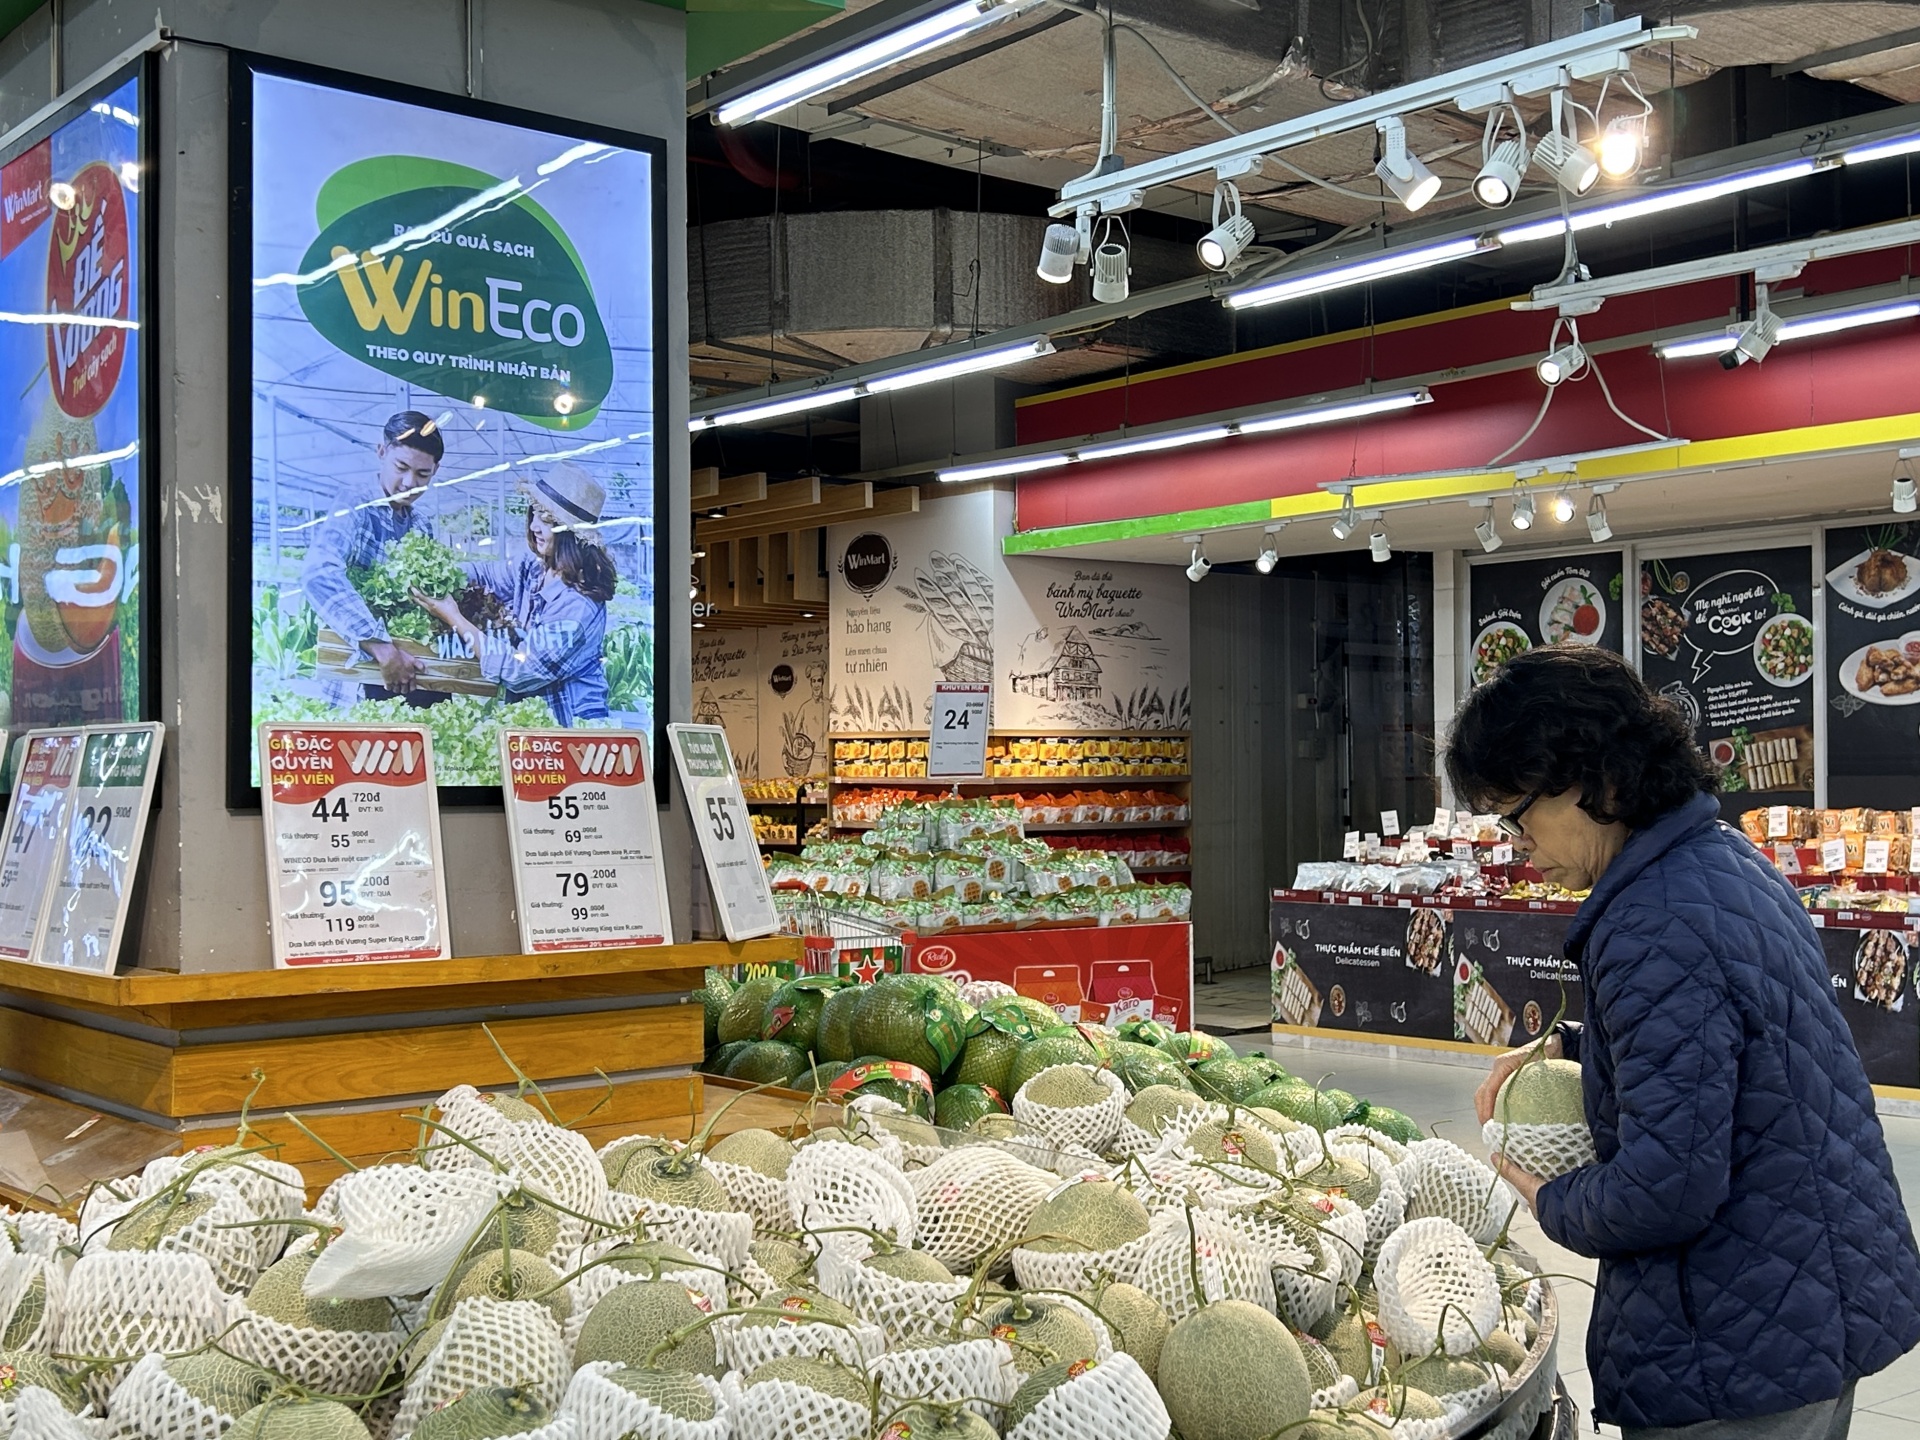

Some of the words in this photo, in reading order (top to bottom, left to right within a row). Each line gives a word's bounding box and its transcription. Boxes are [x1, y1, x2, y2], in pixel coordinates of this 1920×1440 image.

[456, 233, 490, 251] QUẢ
[493, 240, 535, 258] SẠCH
[330, 245, 586, 348] WinEco
[366, 345, 409, 361] THEO
[412, 350, 446, 366] QUY
[449, 354, 494, 373] TRÌNH
[497, 361, 537, 379] NHẬT
[540, 364, 571, 383] BẢN
[847, 553, 886, 570] WinMart
[1046, 582, 1076, 598] bánh
[1096, 583, 1143, 605] baguette
[1055, 601, 1114, 620] WinMart
[846, 619, 865, 634] hảo
[867, 618, 892, 634] hạng
[1708, 611, 1752, 634] COOK
[859, 658, 888, 673] nhiên
[944, 709, 969, 730] 24
[296, 734, 333, 753] ĐẶC
[532, 738, 563, 754] ĐẶC
[271, 752, 333, 770] QUYỀN
[511, 755, 565, 771] QUYỀN
[273, 772, 299, 786] HỘI
[302, 771, 335, 785] VIÊN
[513, 772, 537, 786] HỘI
[539, 771, 566, 784] VIÊN
[312, 797, 349, 824] 44
[548, 796, 580, 820] 55
[706, 797, 735, 842] 55
[331, 834, 350, 848] 55
[565, 830, 581, 843] 69
[283, 856, 312, 864] WINECO
[556, 873, 589, 897] 79
[319, 880, 357, 908] 95
[571, 907, 588, 920] 99
[326, 918, 355, 933] 119
[1315, 943, 1337, 954] THỰC
[1362, 944, 1380, 956] CHẾ
[1381, 945, 1401, 957] BIẾN
[1335, 956, 1380, 967] Delicatessen
[1506, 955, 1532, 968] THỰC
[1114, 998, 1140, 1015] Karo
